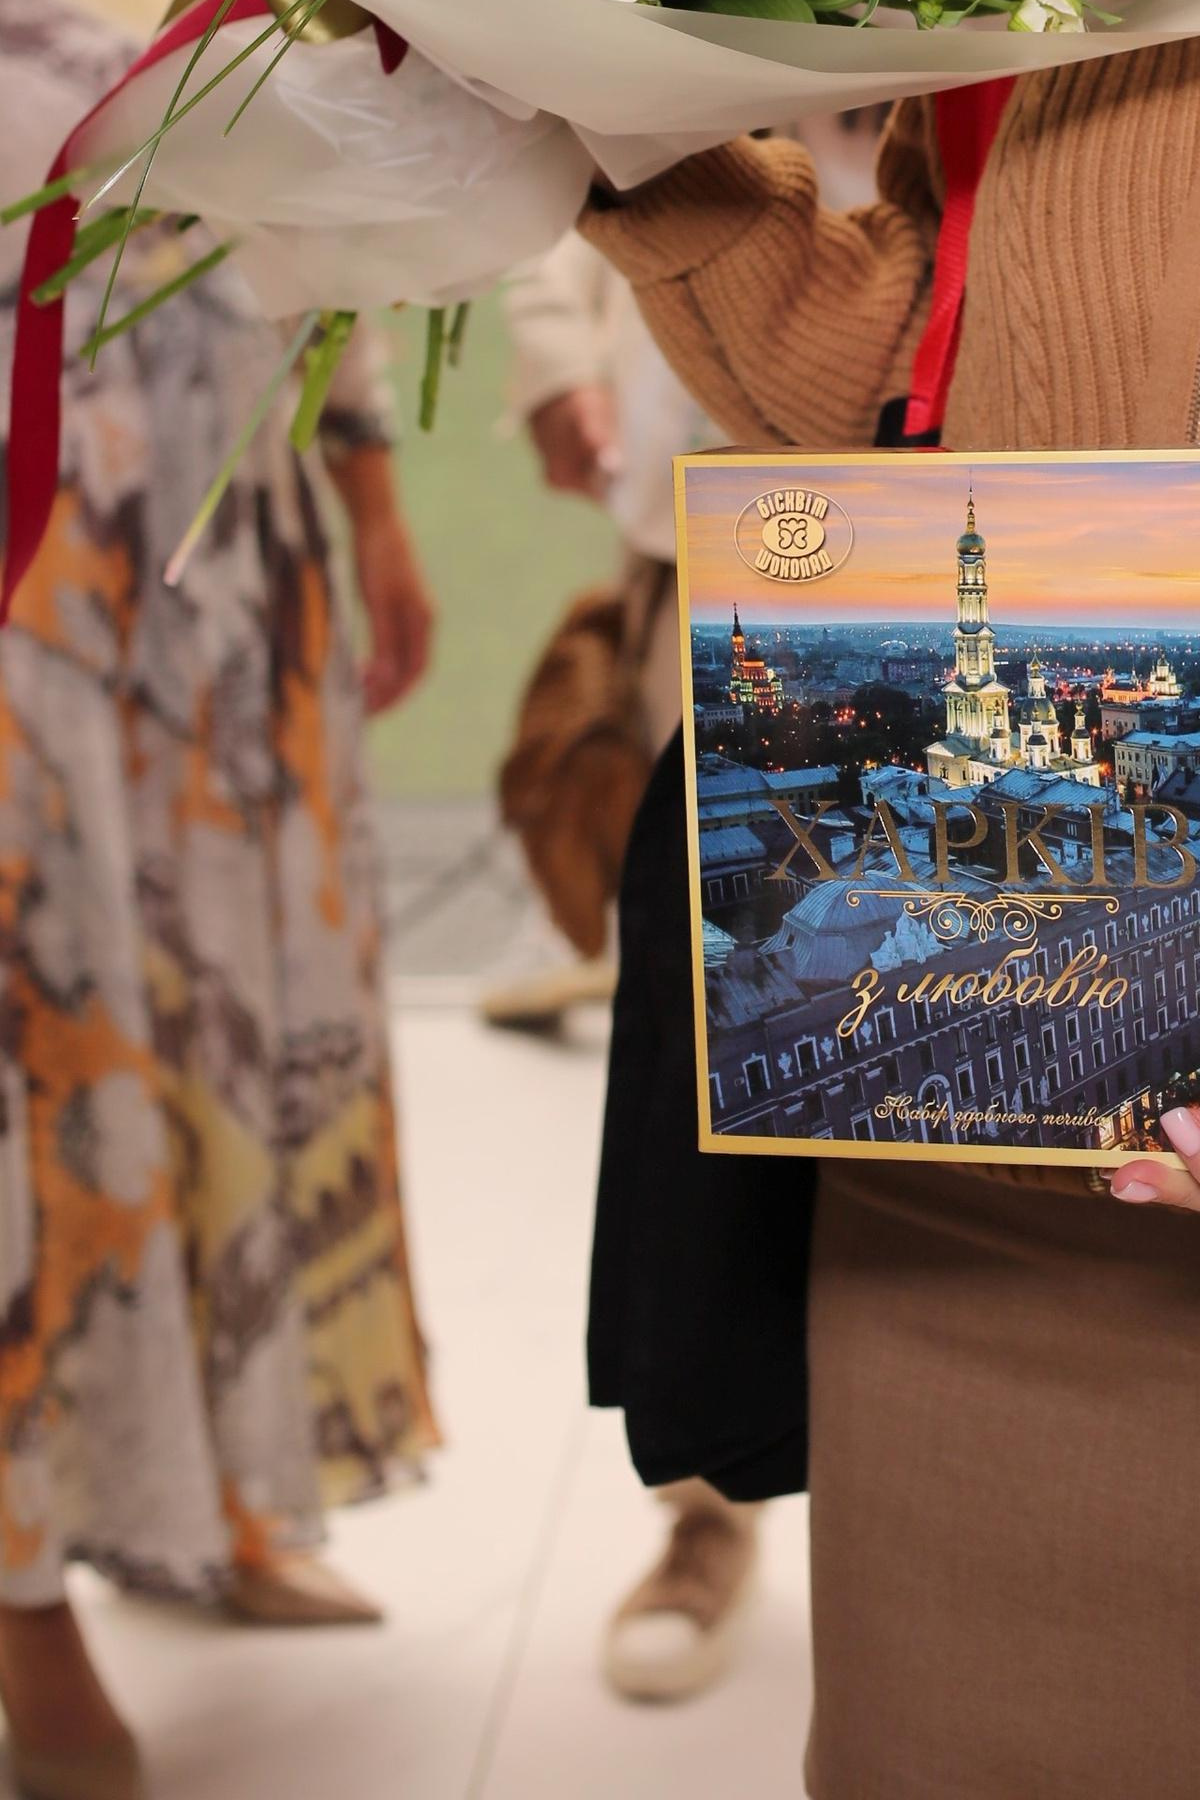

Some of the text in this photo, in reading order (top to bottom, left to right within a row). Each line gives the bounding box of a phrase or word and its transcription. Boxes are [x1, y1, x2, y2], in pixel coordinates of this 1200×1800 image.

[764, 800, 1198, 889] ХАРКІВ
[837, 968, 885, 1038] з
[874, 1095, 949, 1129] Набір
